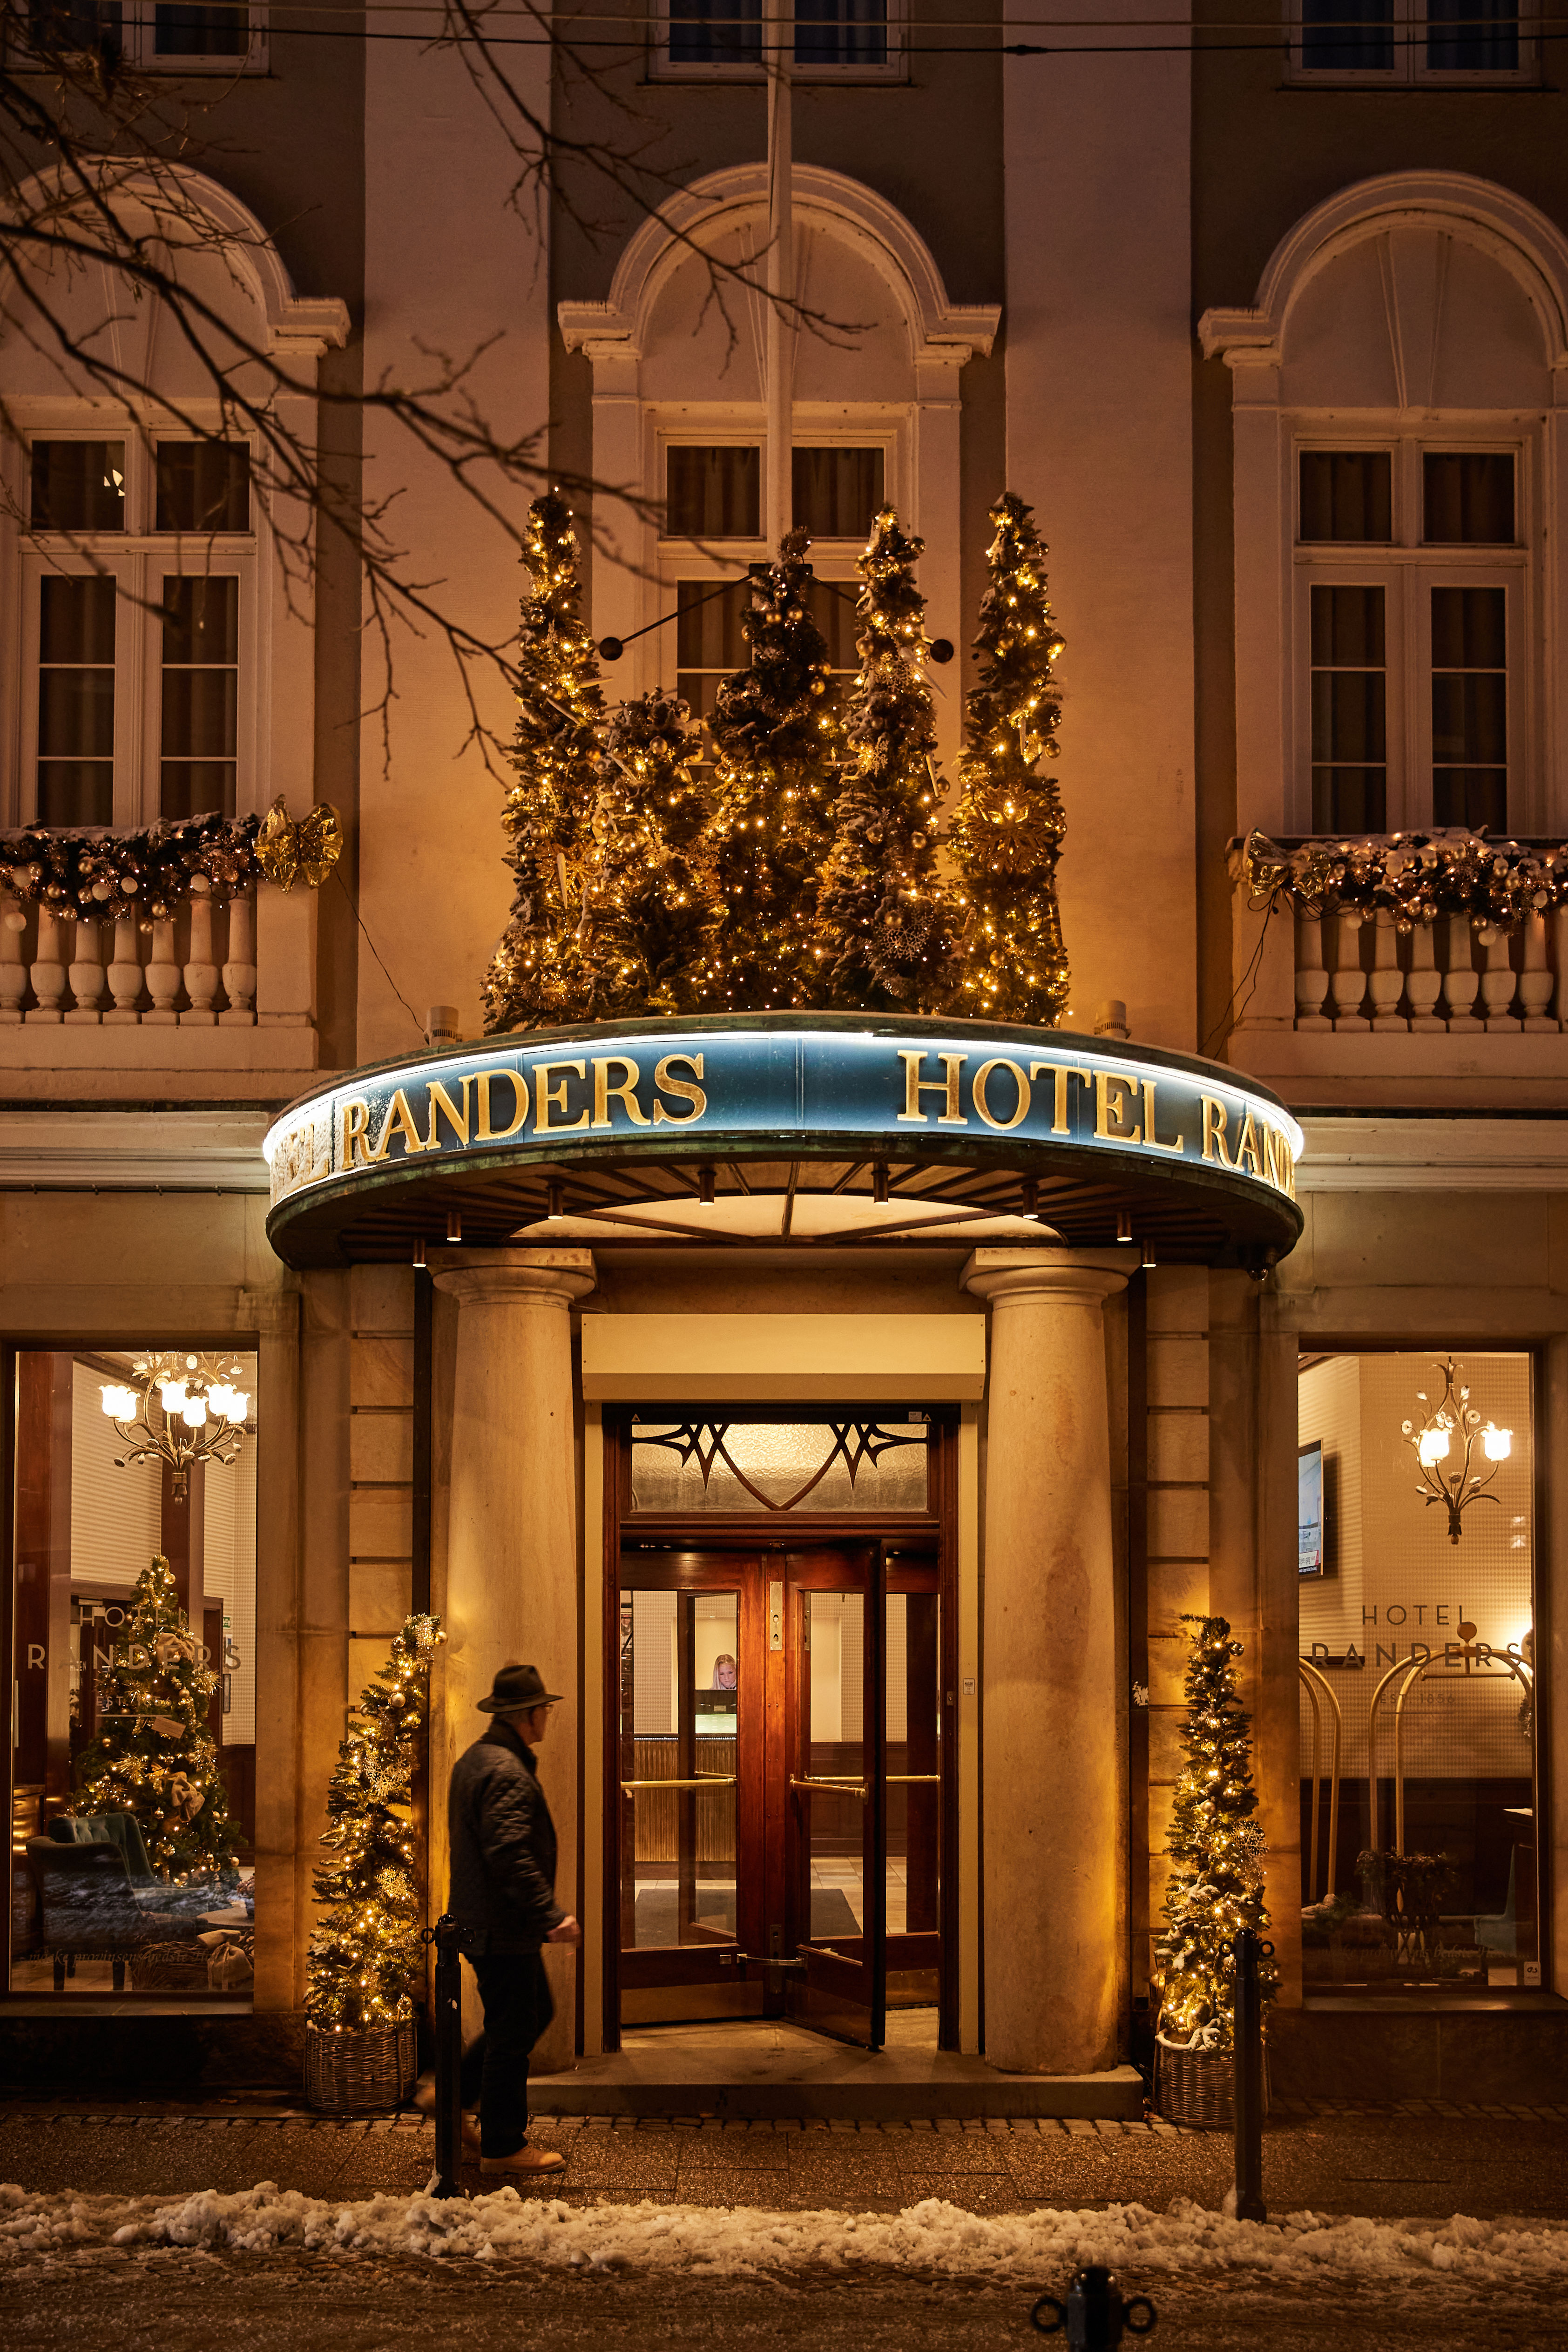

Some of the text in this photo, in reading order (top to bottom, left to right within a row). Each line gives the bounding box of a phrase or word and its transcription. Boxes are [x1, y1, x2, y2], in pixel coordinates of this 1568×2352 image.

[342, 1053, 707, 1170] RANDERS
[897, 1049, 1184, 1154] HOTEL
[80, 1607, 189, 1627] HOTEL
[1362, 1605, 1470, 1625] HOTEL
[1311, 1642, 1521, 1667] RANDERS
[1420, 1693, 1454, 1704] 1856
